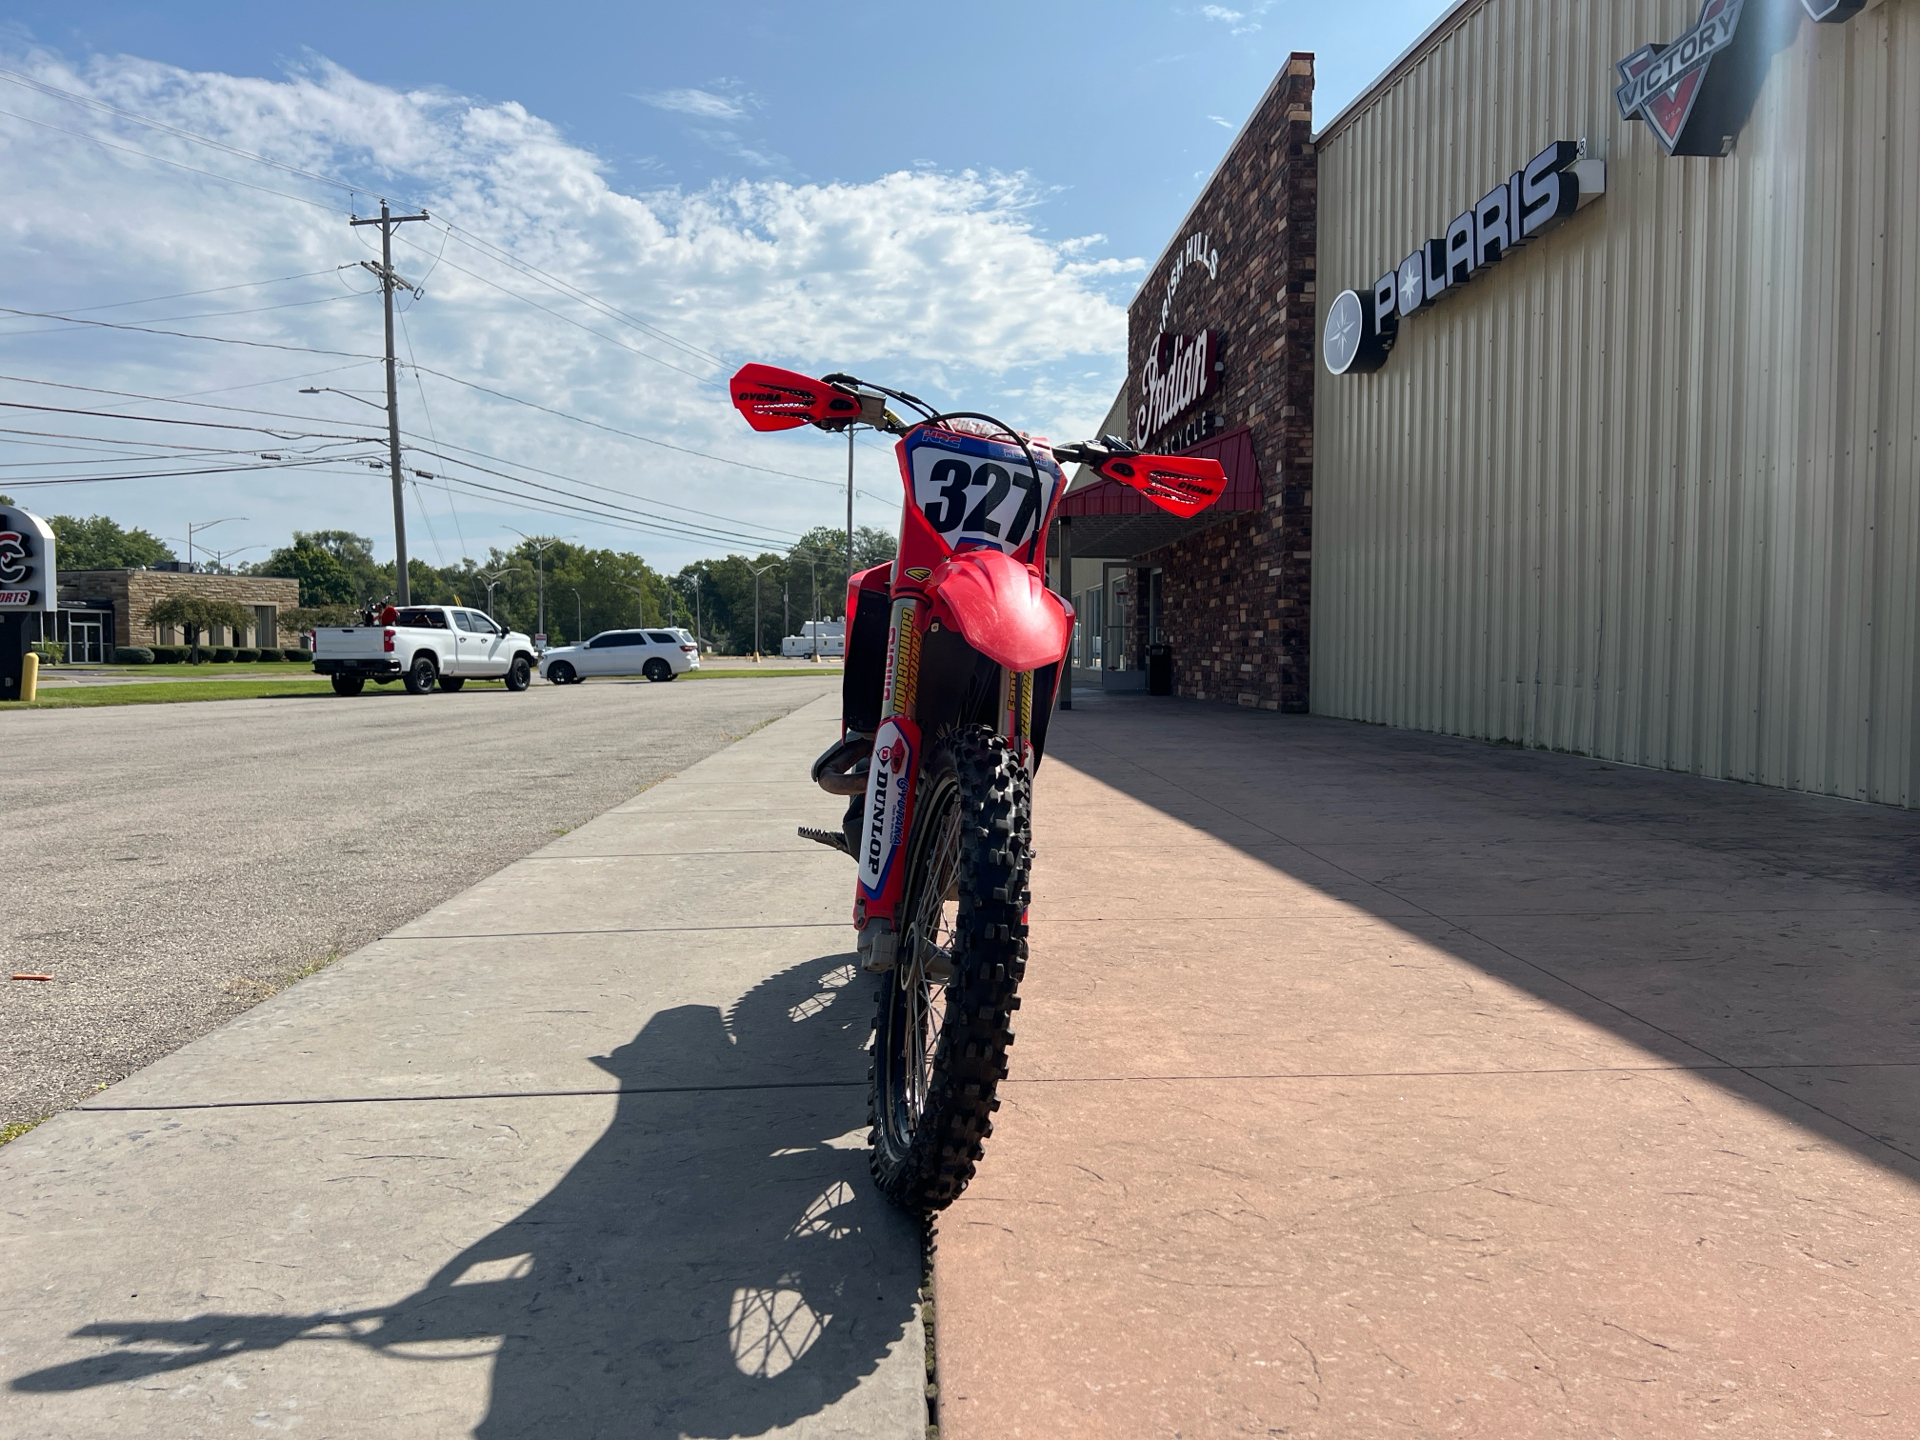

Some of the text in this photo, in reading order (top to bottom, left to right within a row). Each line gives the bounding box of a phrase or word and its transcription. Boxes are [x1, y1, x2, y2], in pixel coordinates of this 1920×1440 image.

[1623, 5, 1738, 107] VICTORY
[1665, 107, 1682, 121] USA
[1186, 231, 1219, 280] HILLS
[1374, 141, 1560, 335] POLARIS
[738, 392, 782, 403] CYCRA
[1136, 329, 1208, 449] Indian
[922, 430, 962, 449] HRC
[924, 459, 1043, 546] 327
[1177, 481, 1213, 495] CYCRA
[893, 607, 914, 714] Connection
[908, 627, 922, 707] Factory
[867, 769, 888, 875] DUNLOP
[892, 790, 908, 846] YUTAKA
